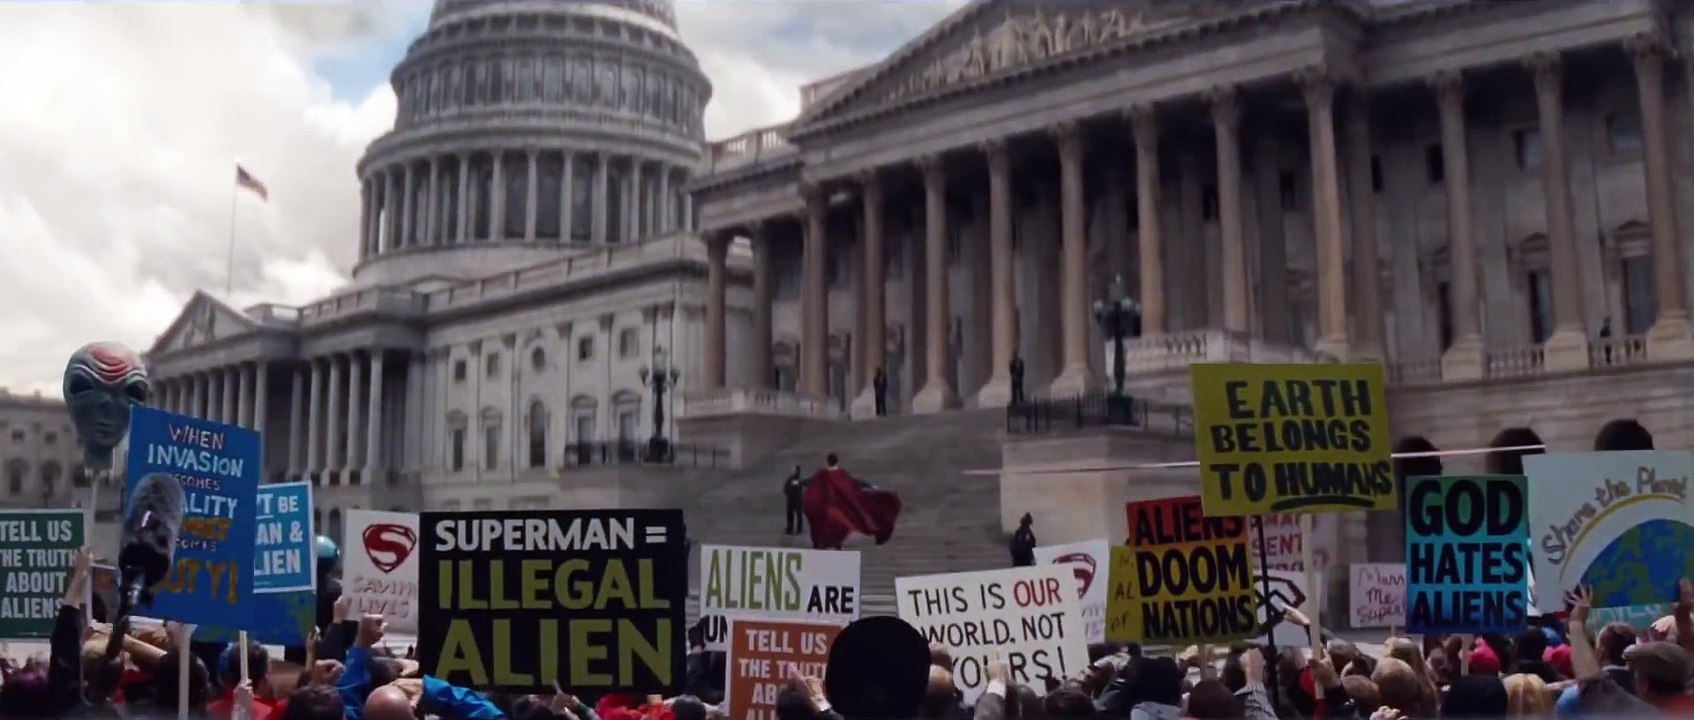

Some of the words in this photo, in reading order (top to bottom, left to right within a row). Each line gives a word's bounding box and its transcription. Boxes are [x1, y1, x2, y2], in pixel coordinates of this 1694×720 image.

[1226, 379, 1372, 419] EARTH
[168, 423, 225, 450] WHEN
[1210, 419, 1372, 454] BELONGS
[147, 443, 244, 477] INVASION
[1210, 462, 1267, 502] TO
[1273, 460, 1393, 497] HUMANS
[278, 496, 299, 513] BE
[1409, 479, 1523, 537] GOD
[0, 520, 42, 541] TELL
[46, 520, 73, 542] US
[256, 521, 283, 545] AN
[289, 520, 304, 543] &
[435, 517, 635, 551] SUPERMAN
[706, 549, 802, 611] ALIENS
[807, 584, 855, 614] ARE
[1136, 543, 1250, 597] DOOM
[1410, 542, 1525, 585] HATES
[6, 572, 67, 593] ABOUT
[438, 557, 672, 610] ILLEGAL
[908, 586, 968, 617] THIS
[980, 582, 1006, 610] IS
[1013, 577, 1063, 607] OUR
[1142, 595, 1255, 638] NATIONS
[1411, 590, 1524, 627] ALIENS
[745, 629, 794, 654] TELL
[801, 632, 828, 655] US
[1021, 612, 1065, 642] NOT
[435, 618, 673, 687] ALIEN
[738, 658, 771, 678] THE
